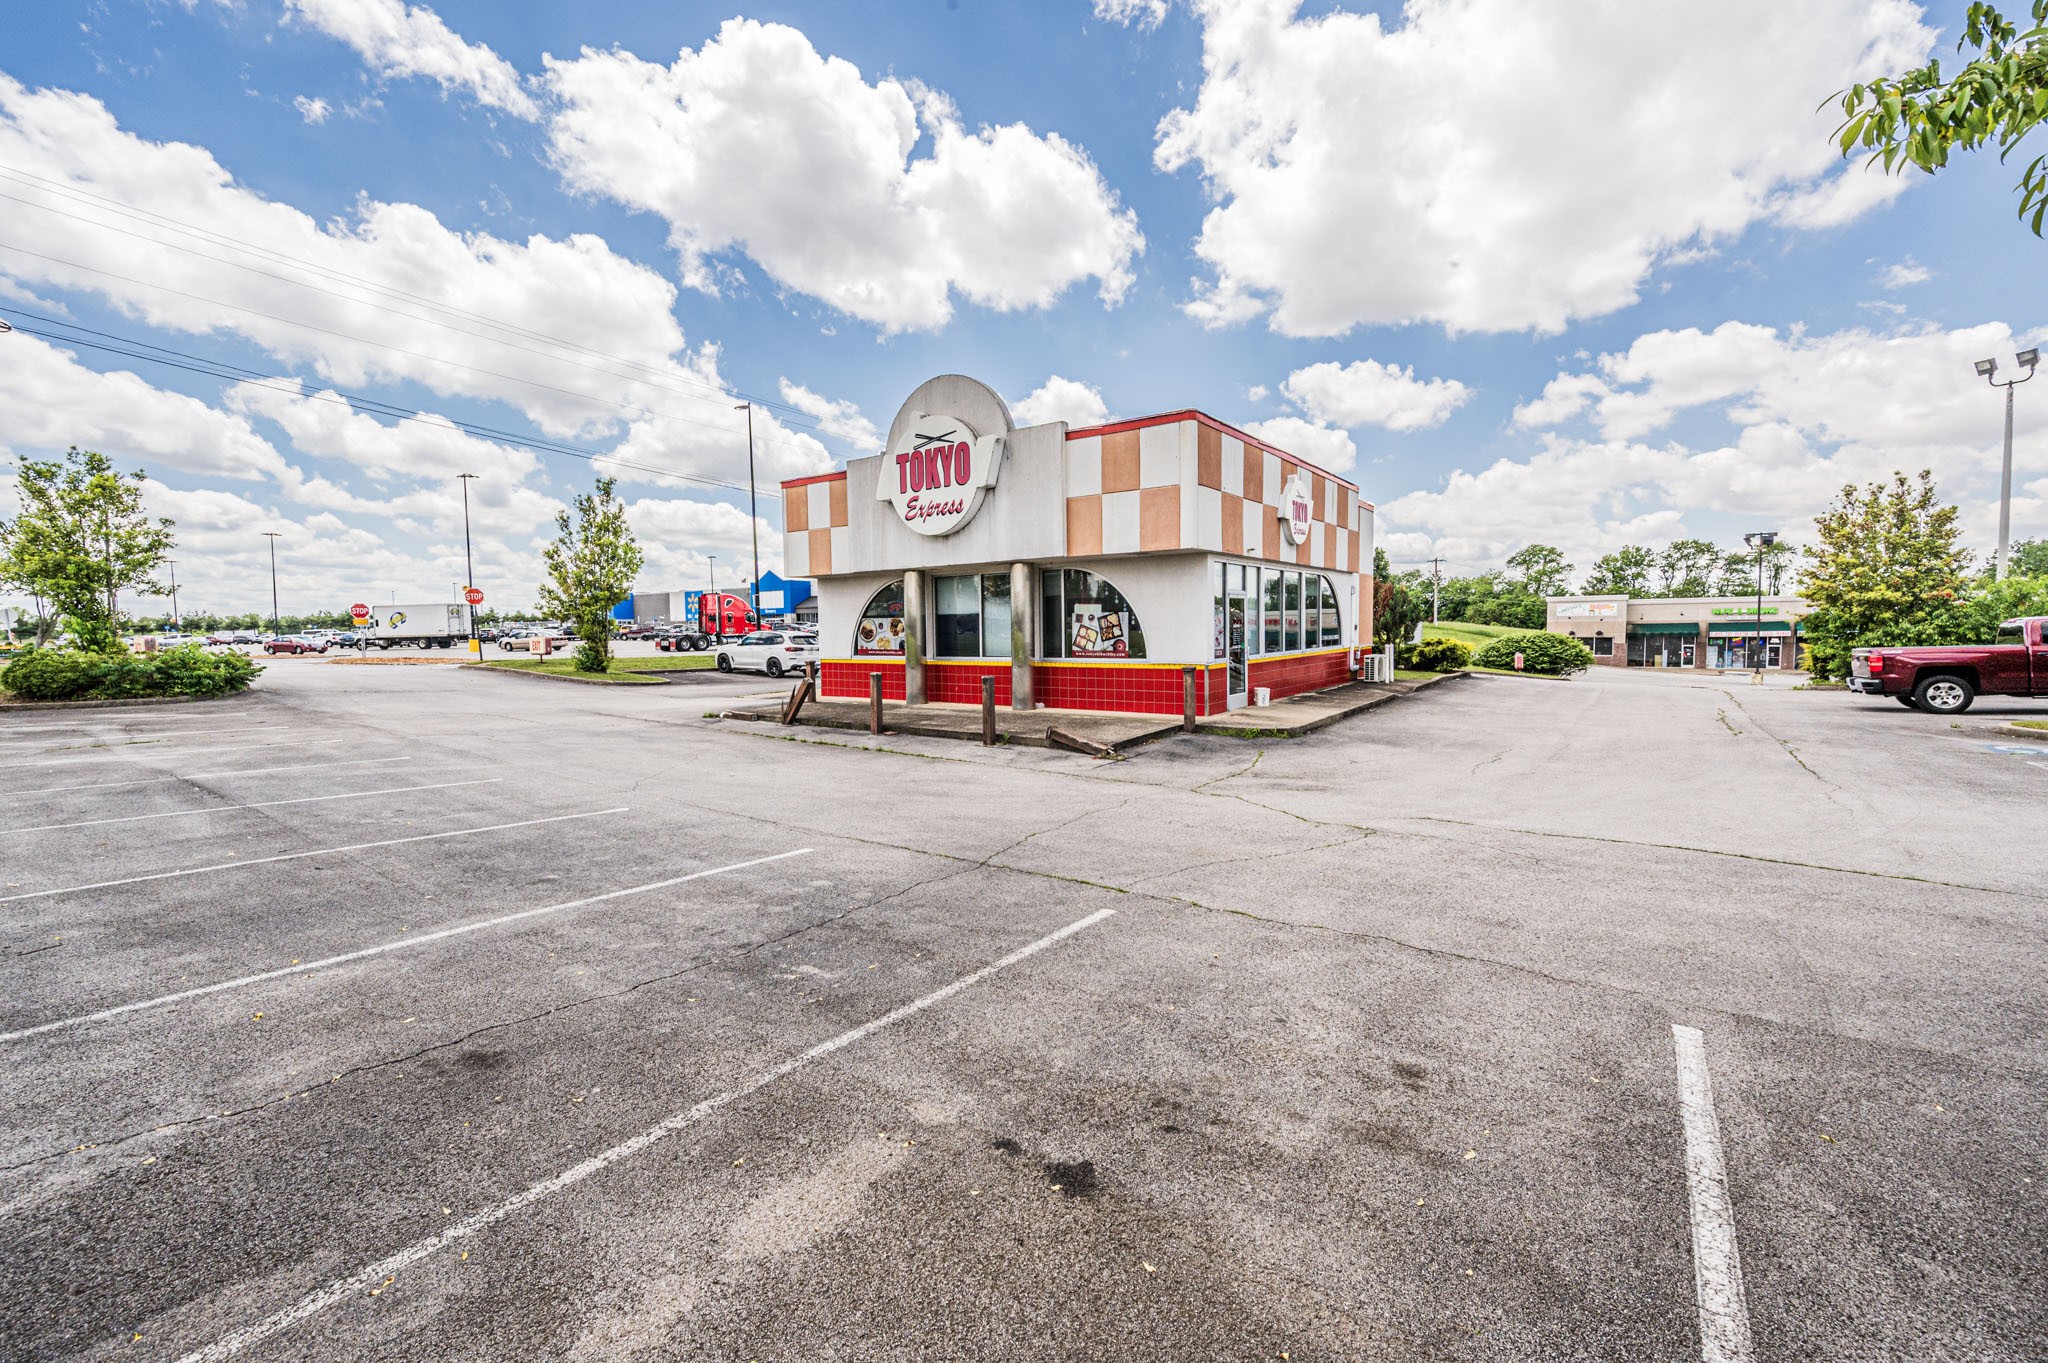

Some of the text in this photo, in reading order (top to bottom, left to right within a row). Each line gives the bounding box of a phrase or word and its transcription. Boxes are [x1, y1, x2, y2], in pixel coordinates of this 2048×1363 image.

[896, 441, 971, 494] TOKYO
[905, 495, 964, 523] Express
[1292, 500, 1308, 524] TOKYO
[465, 593, 483, 601] STOP
[351, 607, 369, 615] STOP
